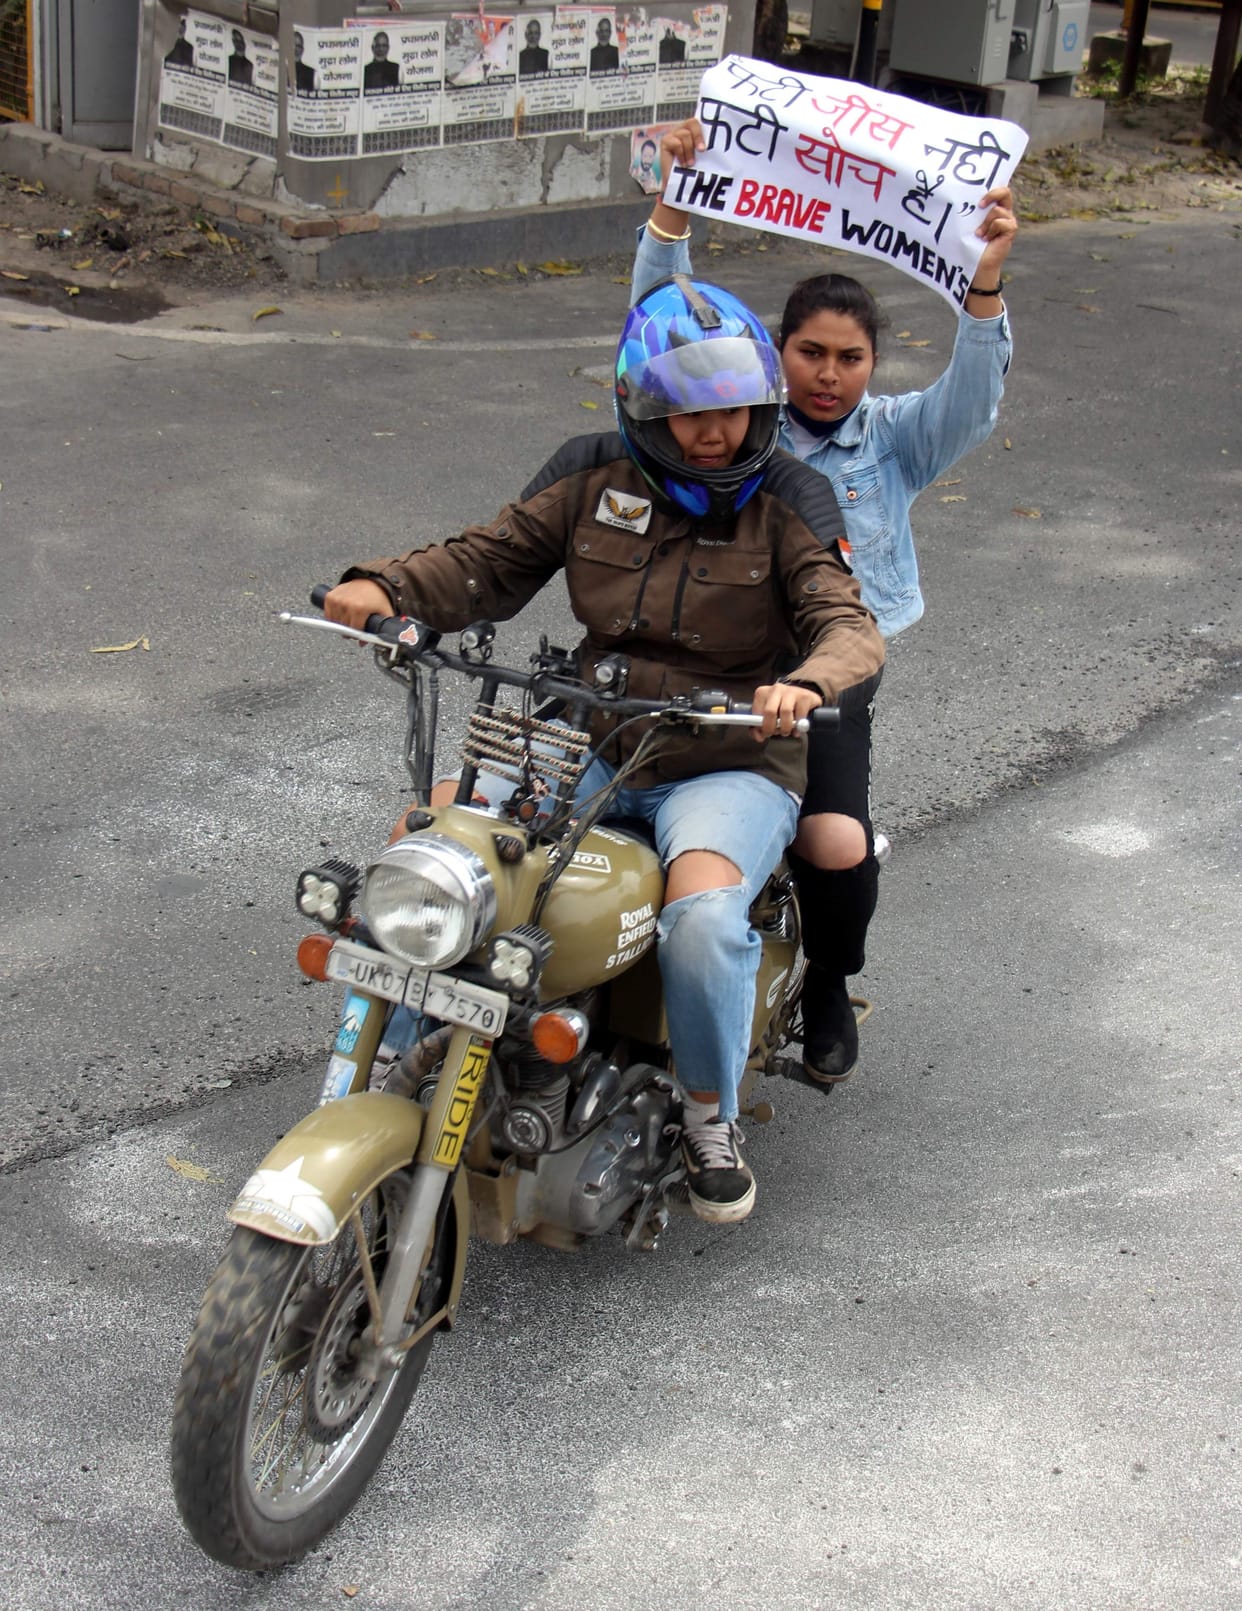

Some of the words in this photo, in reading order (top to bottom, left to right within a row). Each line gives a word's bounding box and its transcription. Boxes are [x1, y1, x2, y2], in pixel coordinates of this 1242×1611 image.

[323, 71, 353, 81] योजना
[406, 65, 434, 76] योजना
[700, 96, 789, 162] फटी
[794, 127, 897, 203] सोच
[673, 166, 733, 211] THE
[733, 179, 832, 234] BRAVE
[620, 902, 654, 930] ROYAL
[617, 917, 657, 951] ENFIELD
[440, 993, 496, 1029] 7570
[434, 1050, 482, 1160] RIDE
